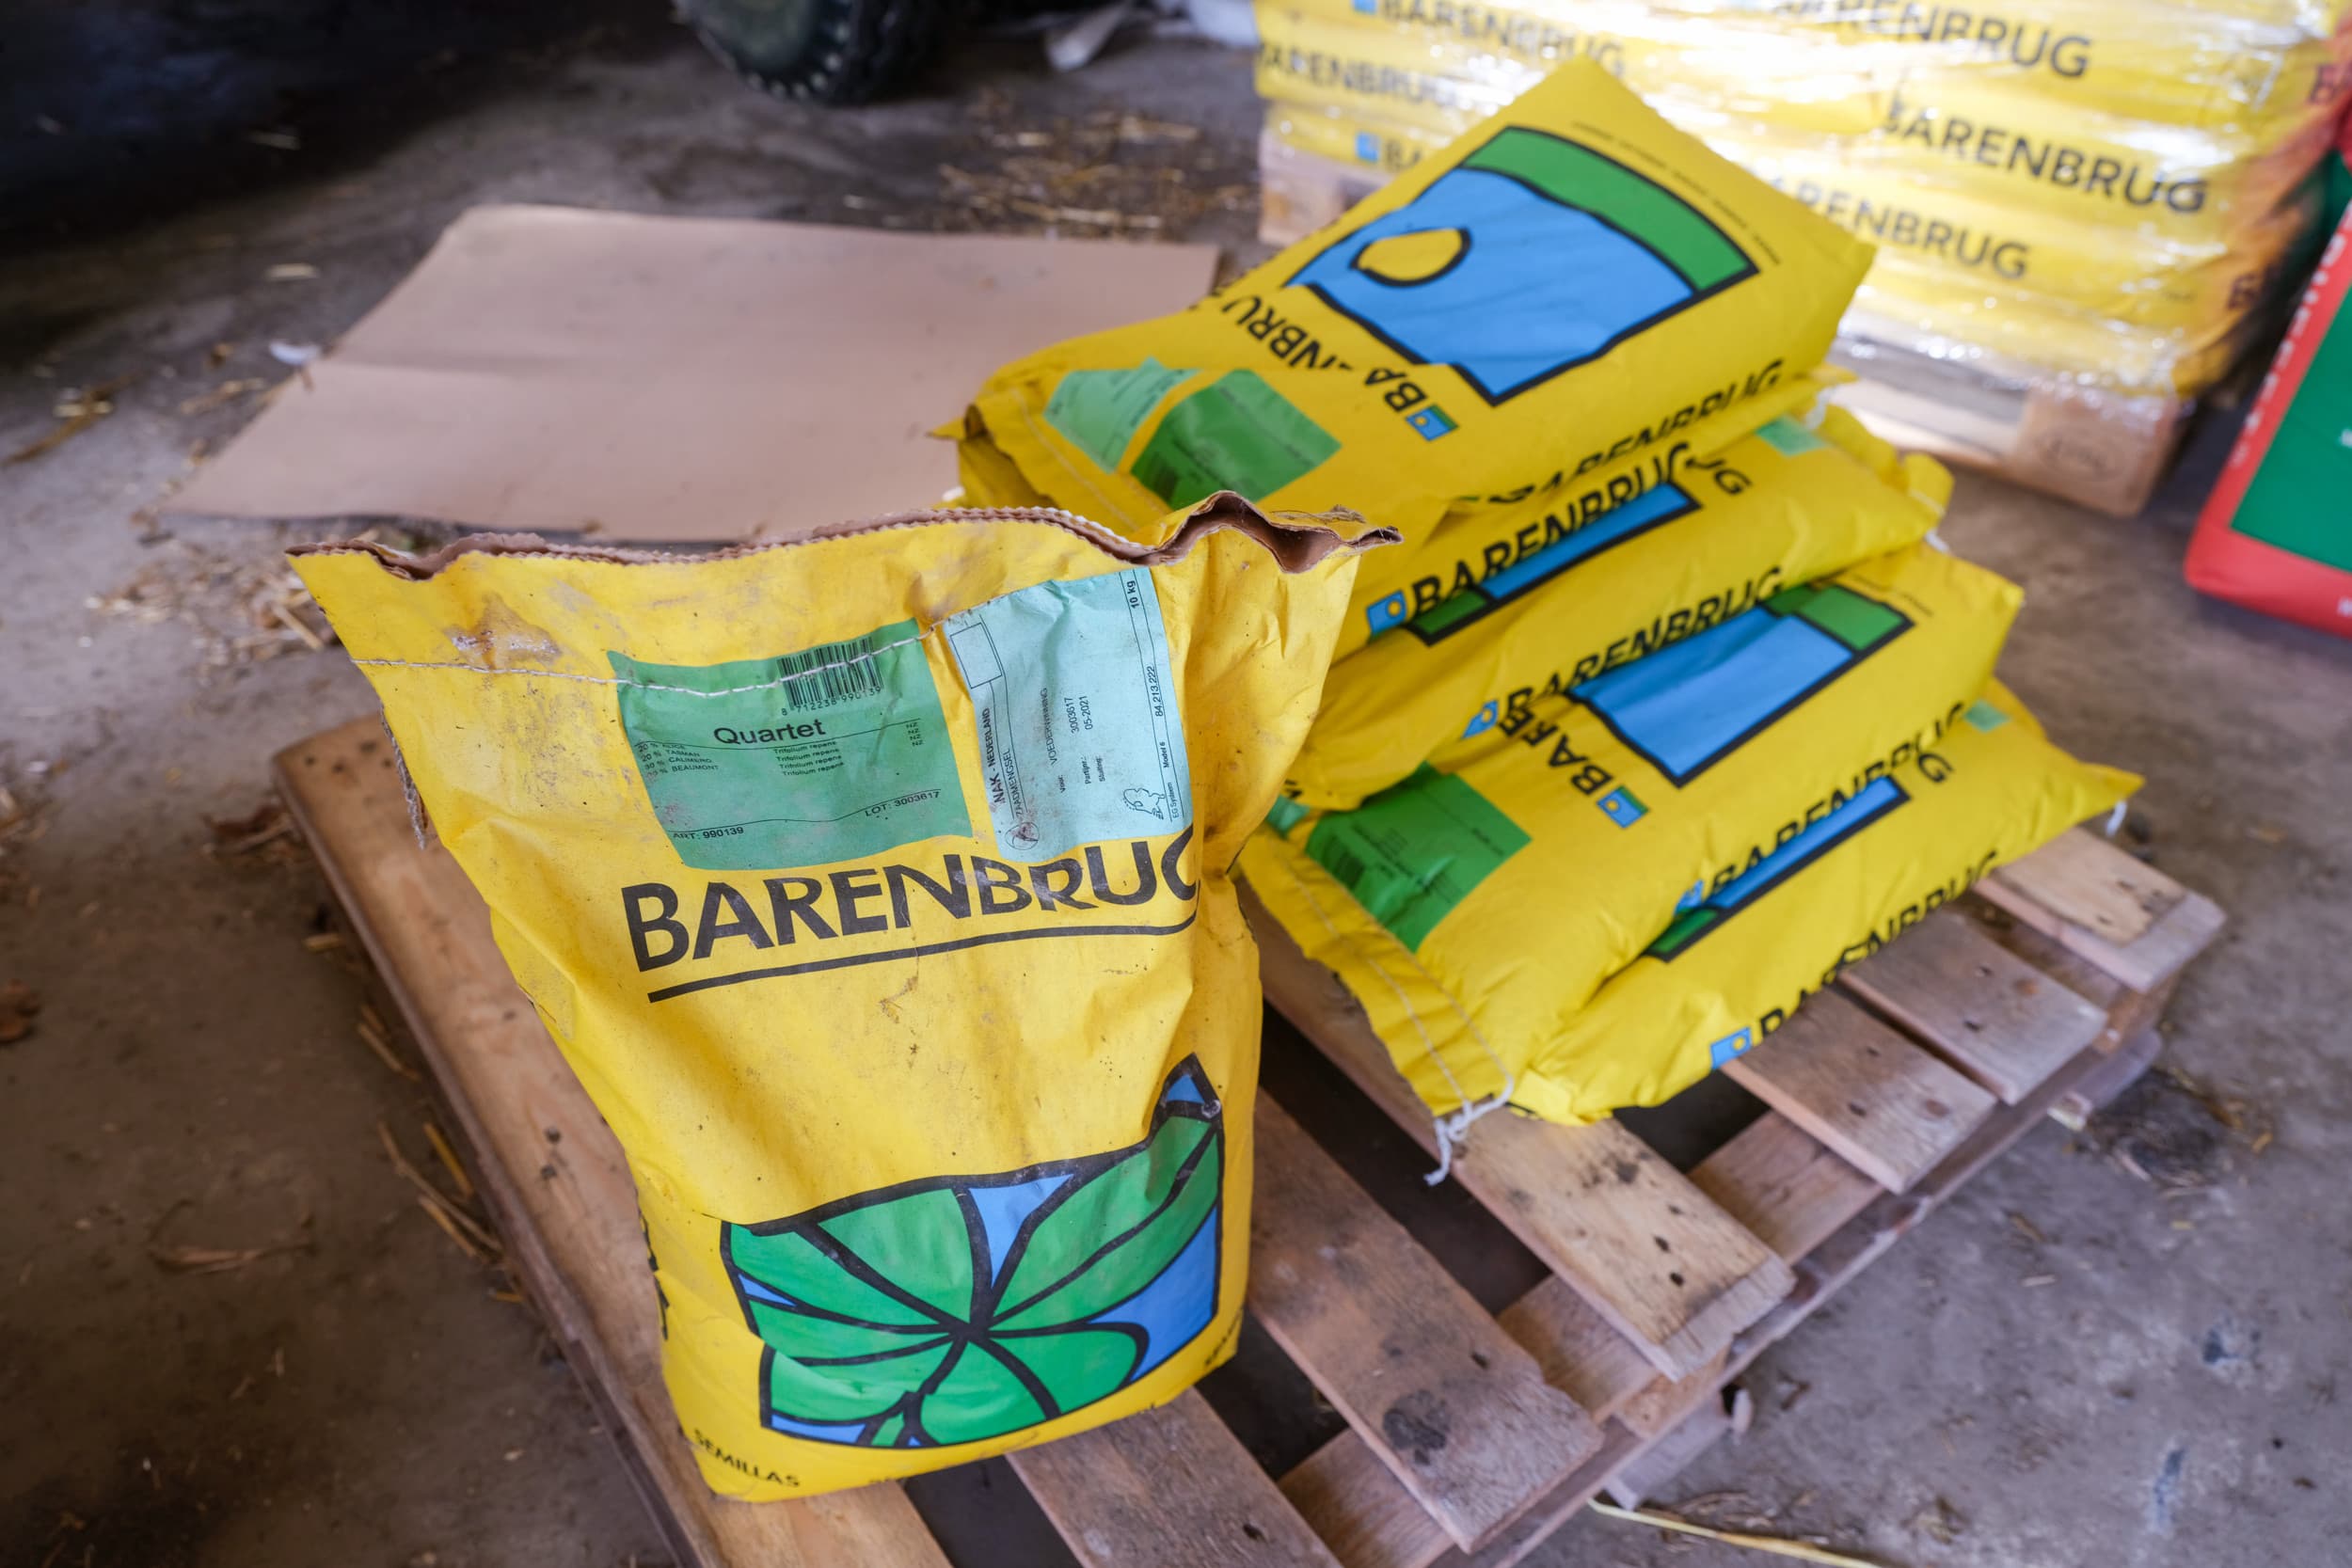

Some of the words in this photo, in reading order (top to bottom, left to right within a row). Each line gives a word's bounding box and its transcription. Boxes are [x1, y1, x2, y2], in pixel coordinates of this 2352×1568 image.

[1127, 580, 1136, 594] kg
[1129, 596, 1140, 610] 10
[1146, 666, 1164, 717] 84.213.222
[1064, 697, 1080, 734] 3003617
[1079, 696, 1094, 730] 05-2021
[714, 718, 826, 745] Quartet
[982, 707, 996, 768] NEDERLAND
[1161, 746, 1170, 768] Model
[989, 772, 1006, 804] NAK
[1002, 748, 1024, 817] ZAADMENGSEL
[865, 803, 892, 817] LOT:
[894, 791, 940, 807] 3003617
[1172, 808, 1179, 819] EG
[702, 826, 745, 839] 990139
[692, 1429, 801, 1488] SEMILLAS
